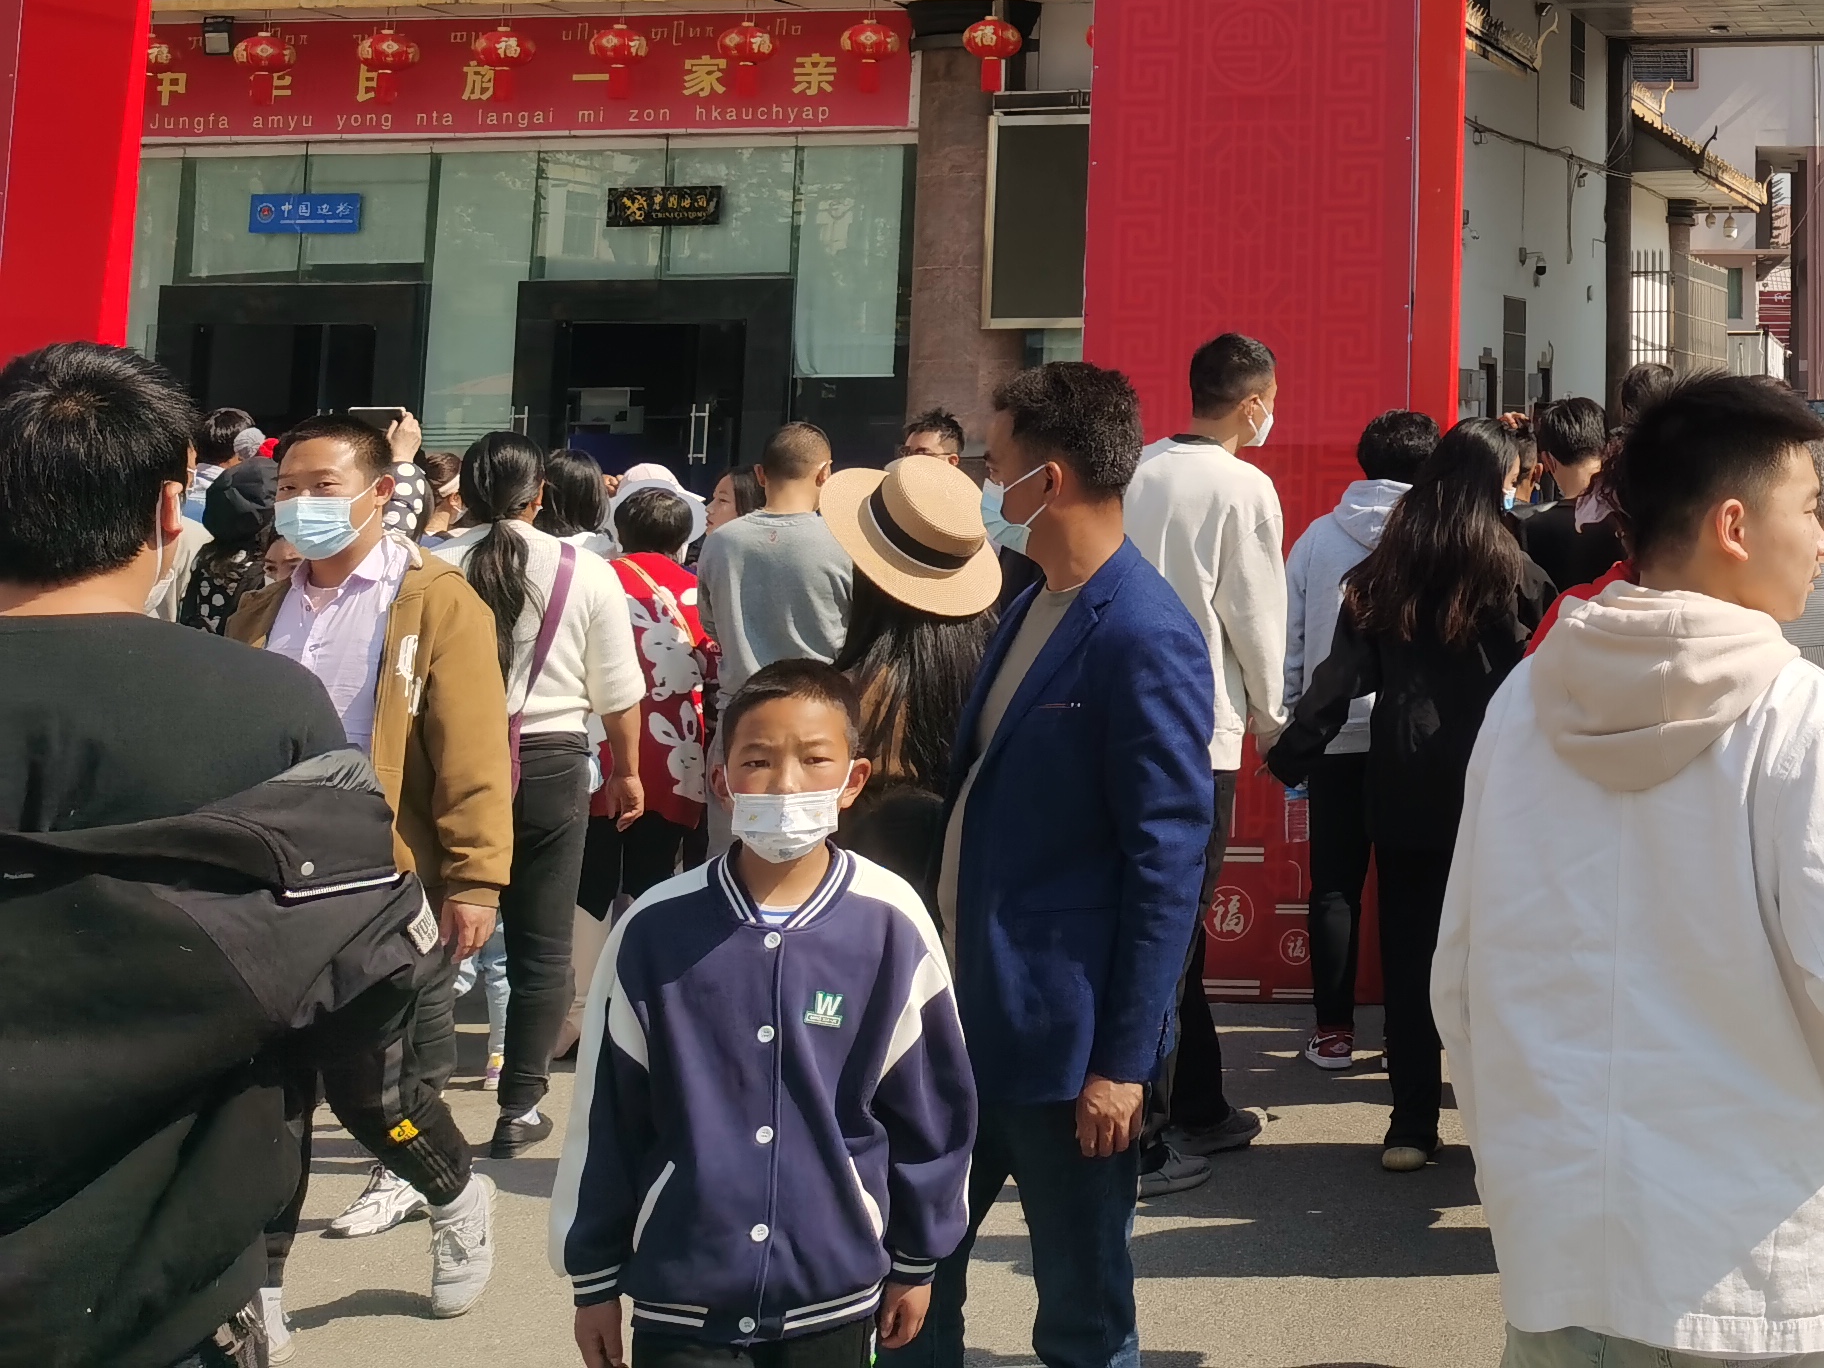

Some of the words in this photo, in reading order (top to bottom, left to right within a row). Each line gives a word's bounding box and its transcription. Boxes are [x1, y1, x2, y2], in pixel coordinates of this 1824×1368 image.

[974, 25, 997, 46] 福
[252, 113, 312, 131] amyu
[337, 112, 392, 131] yong
[416, 110, 453, 125] nta
[478, 107, 554, 127] langai
[578, 106, 604, 123] mi
[629, 107, 670, 122] zon
[695, 104, 830, 123] hkauchyap
[1211, 894, 1245, 934] 福
[1287, 936, 1307, 959] 福
